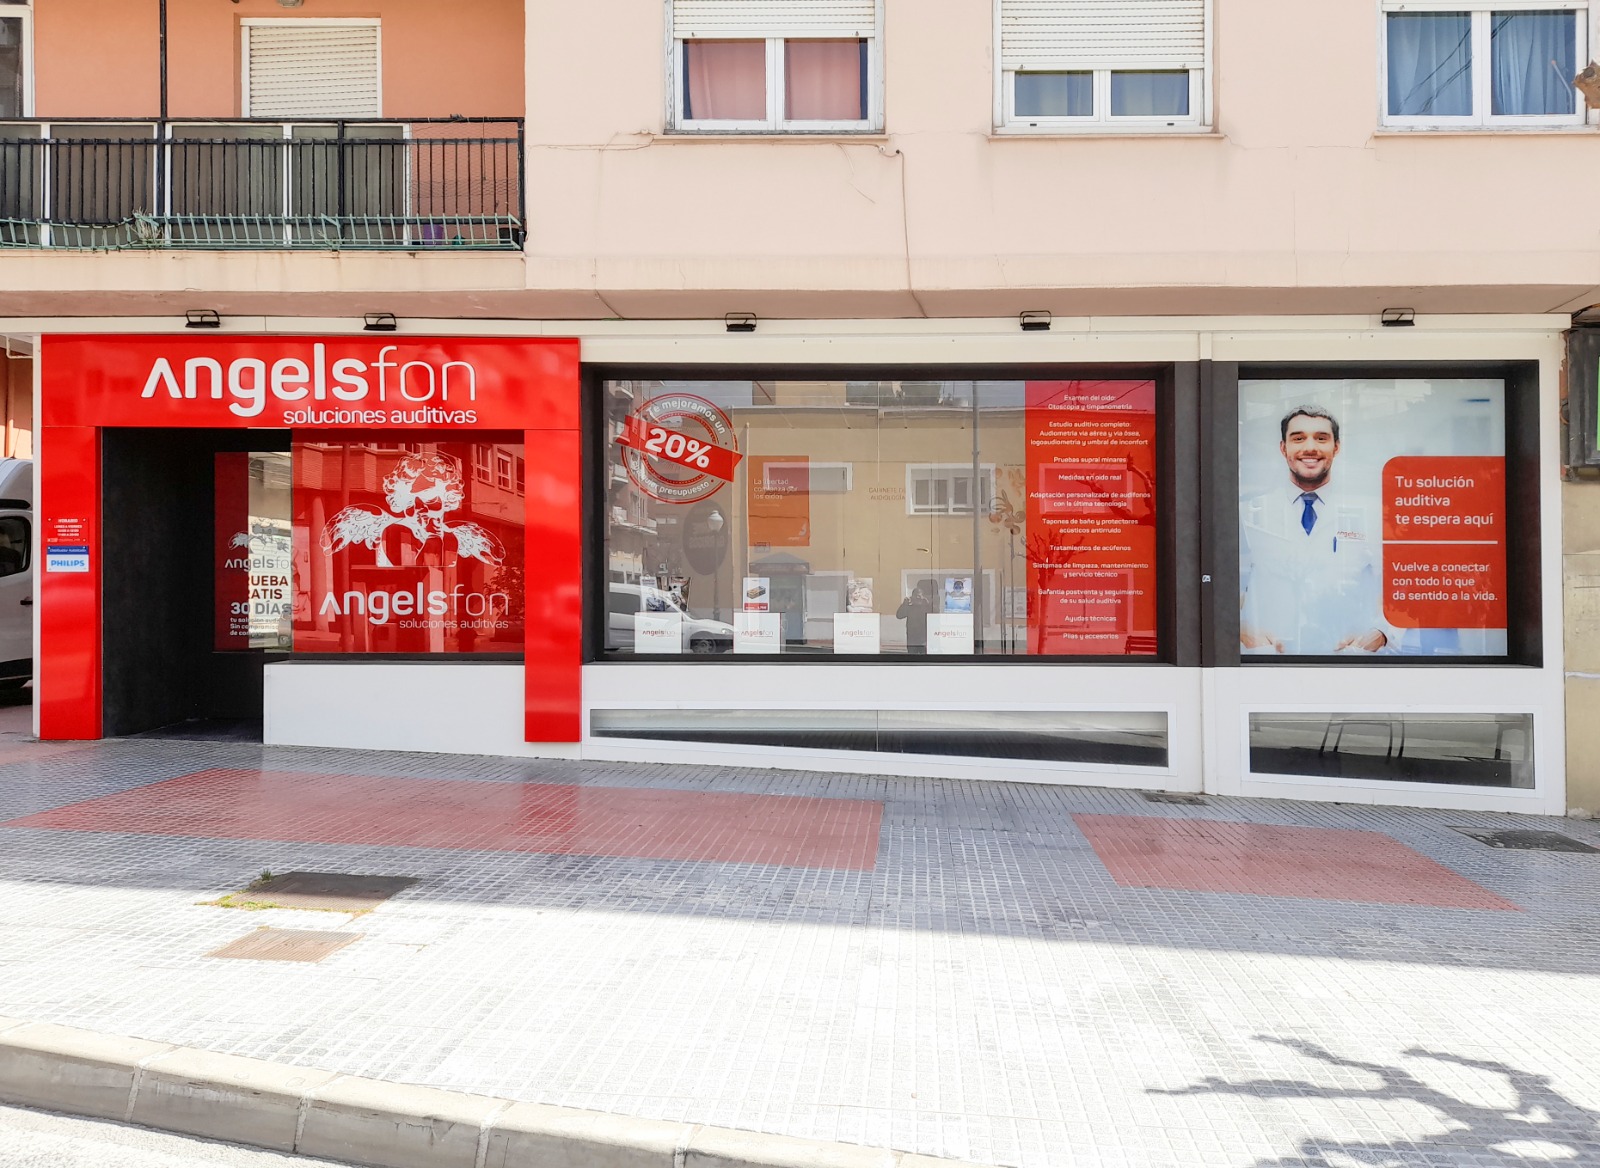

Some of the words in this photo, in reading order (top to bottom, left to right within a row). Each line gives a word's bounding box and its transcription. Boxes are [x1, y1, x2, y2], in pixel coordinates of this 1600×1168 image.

[141, 343, 476, 417] Angelsfon
[283, 406, 386, 424] soluciones
[391, 406, 477, 424] auditivas
[646, 405, 660, 416] Te
[662, 399, 716, 422] mejoramos
[715, 421, 726, 434] un
[644, 428, 712, 468] 20%
[1395, 476, 1413, 488] Tu
[1416, 475, 1475, 488] solución
[659, 481, 710, 497] presupuesto
[1395, 494, 1451, 507] auditiva
[1395, 514, 1410, 525] te
[1413, 515, 1461, 527] espera
[1464, 513, 1494, 527] aquí
[1392, 562, 1430, 572] Vuelve
[1432, 564, 1439, 572] a
[1441, 562, 1490, 572] conectar
[1392, 578, 1413, 587] con
[1415, 576, 1440, 587] todo
[1442, 576, 1452, 587] lo
[1454, 578, 1475, 588] que
[1392, 590, 1406, 600] da
[1408, 590, 1449, 600] sentido
[1461, 590, 1470, 600] la
[1473, 590, 1498, 600] vida.
[230, 602, 251, 615] 30
[319, 582, 509, 625] Angelsfon
[399, 617, 458, 629] soluciones
[460, 617, 509, 629] auditivas
